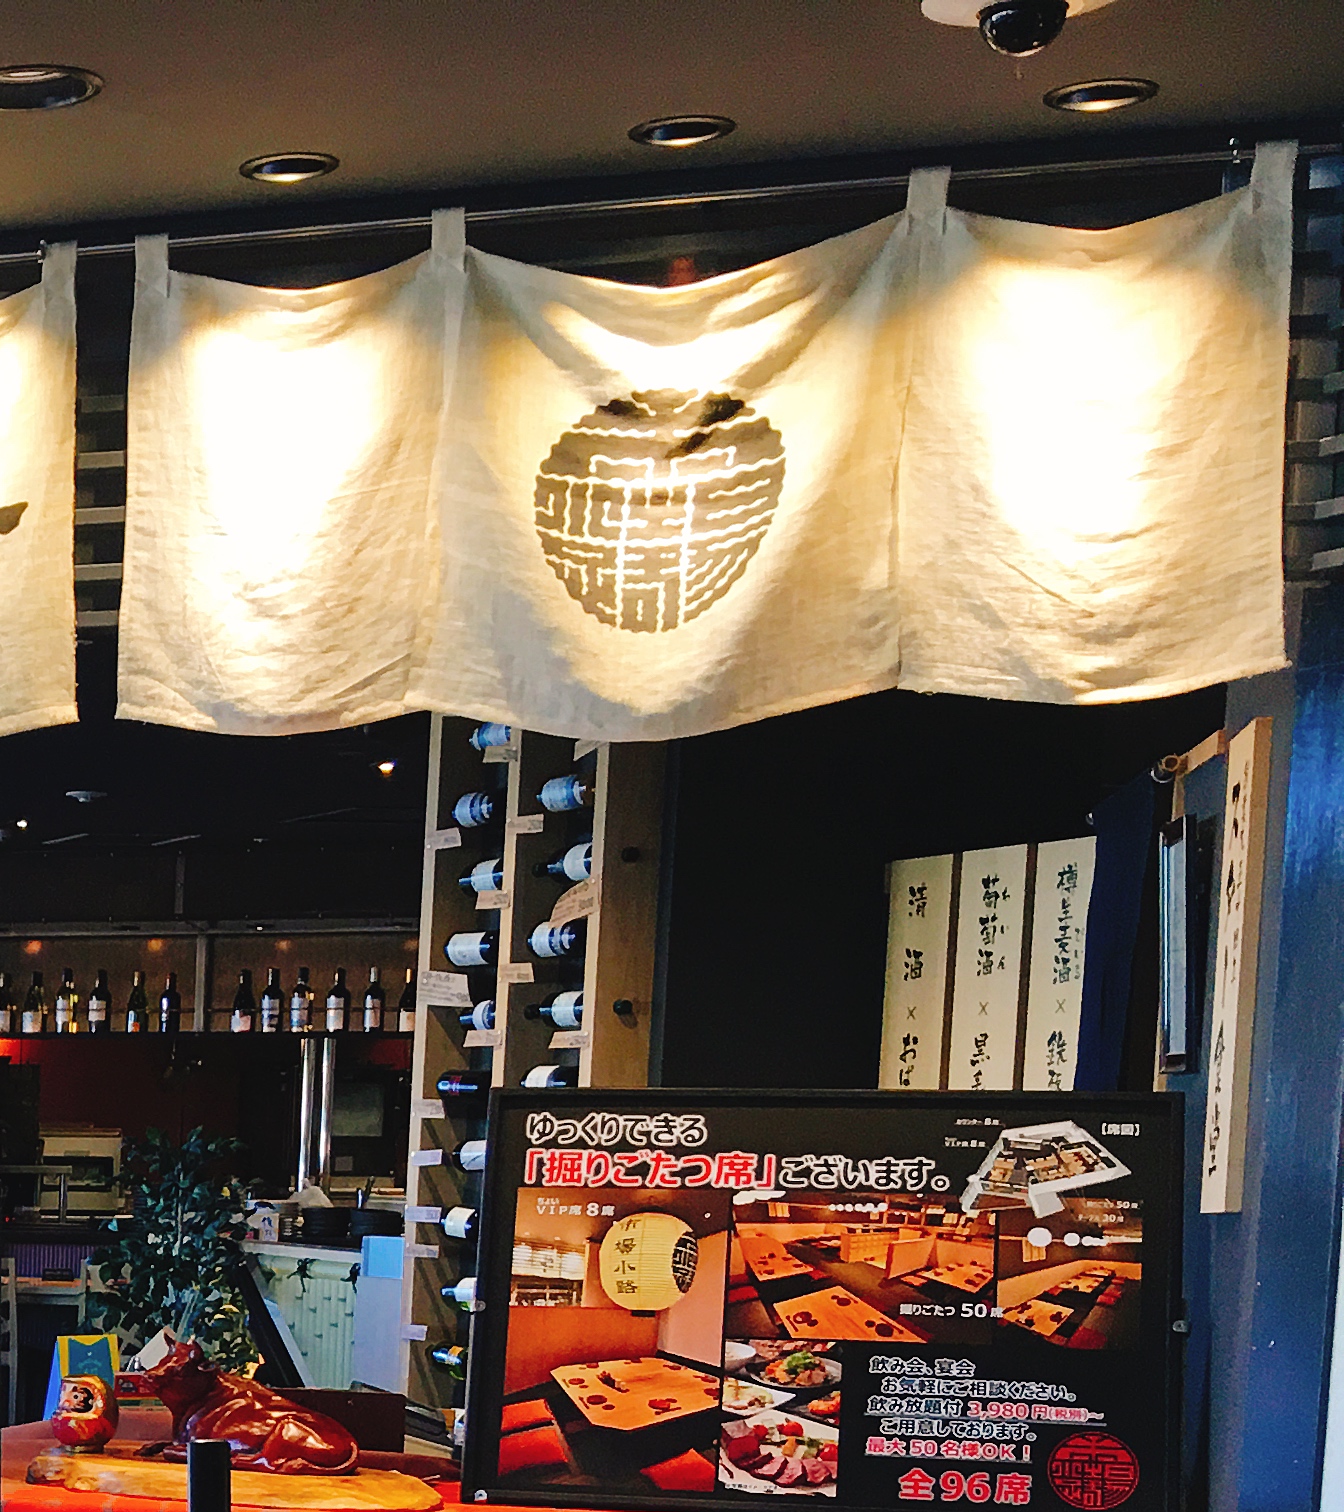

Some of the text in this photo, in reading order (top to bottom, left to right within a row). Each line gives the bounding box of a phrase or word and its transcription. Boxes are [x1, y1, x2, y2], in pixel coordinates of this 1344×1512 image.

[525, 1112, 708, 1148] ゆっくりできる
[868, 1355, 977, 1377] 飲み会、宴会
[881, 1376, 1077, 1402] お気軽にご相談ください。
[867, 1396, 962, 1418] 飲み放題付
[879, 1418, 1038, 1441] ご用意しております。
[898, 1467, 1033, 1506] 全96席
